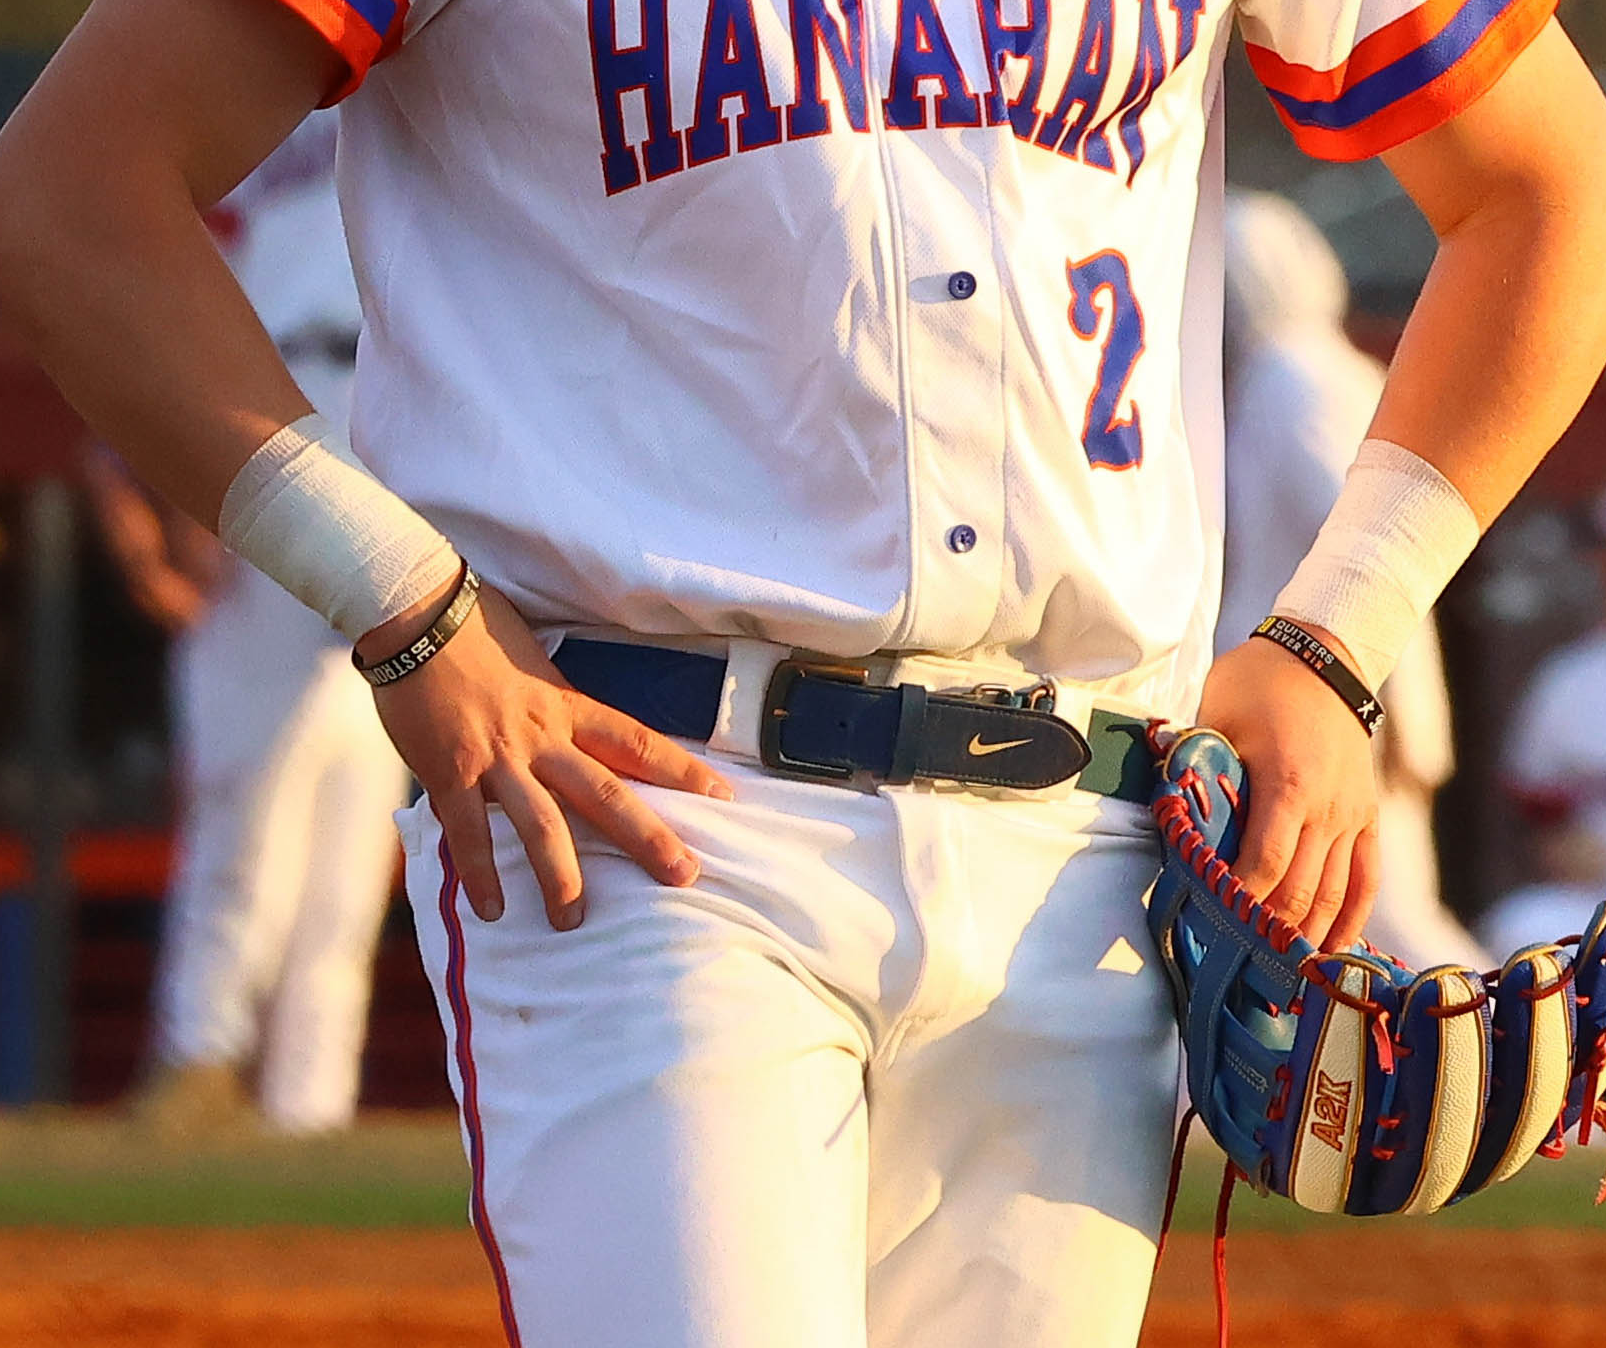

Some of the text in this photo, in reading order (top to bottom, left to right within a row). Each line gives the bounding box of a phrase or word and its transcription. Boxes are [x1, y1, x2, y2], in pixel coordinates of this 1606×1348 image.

[1066, 248, 1146, 472] 2
[411, 636, 436, 662] BE
[1268, 629, 1302, 652] NEVER
[1275, 620, 1335, 665] QUITTERS
[1311, 1070, 1352, 1153] A2K
